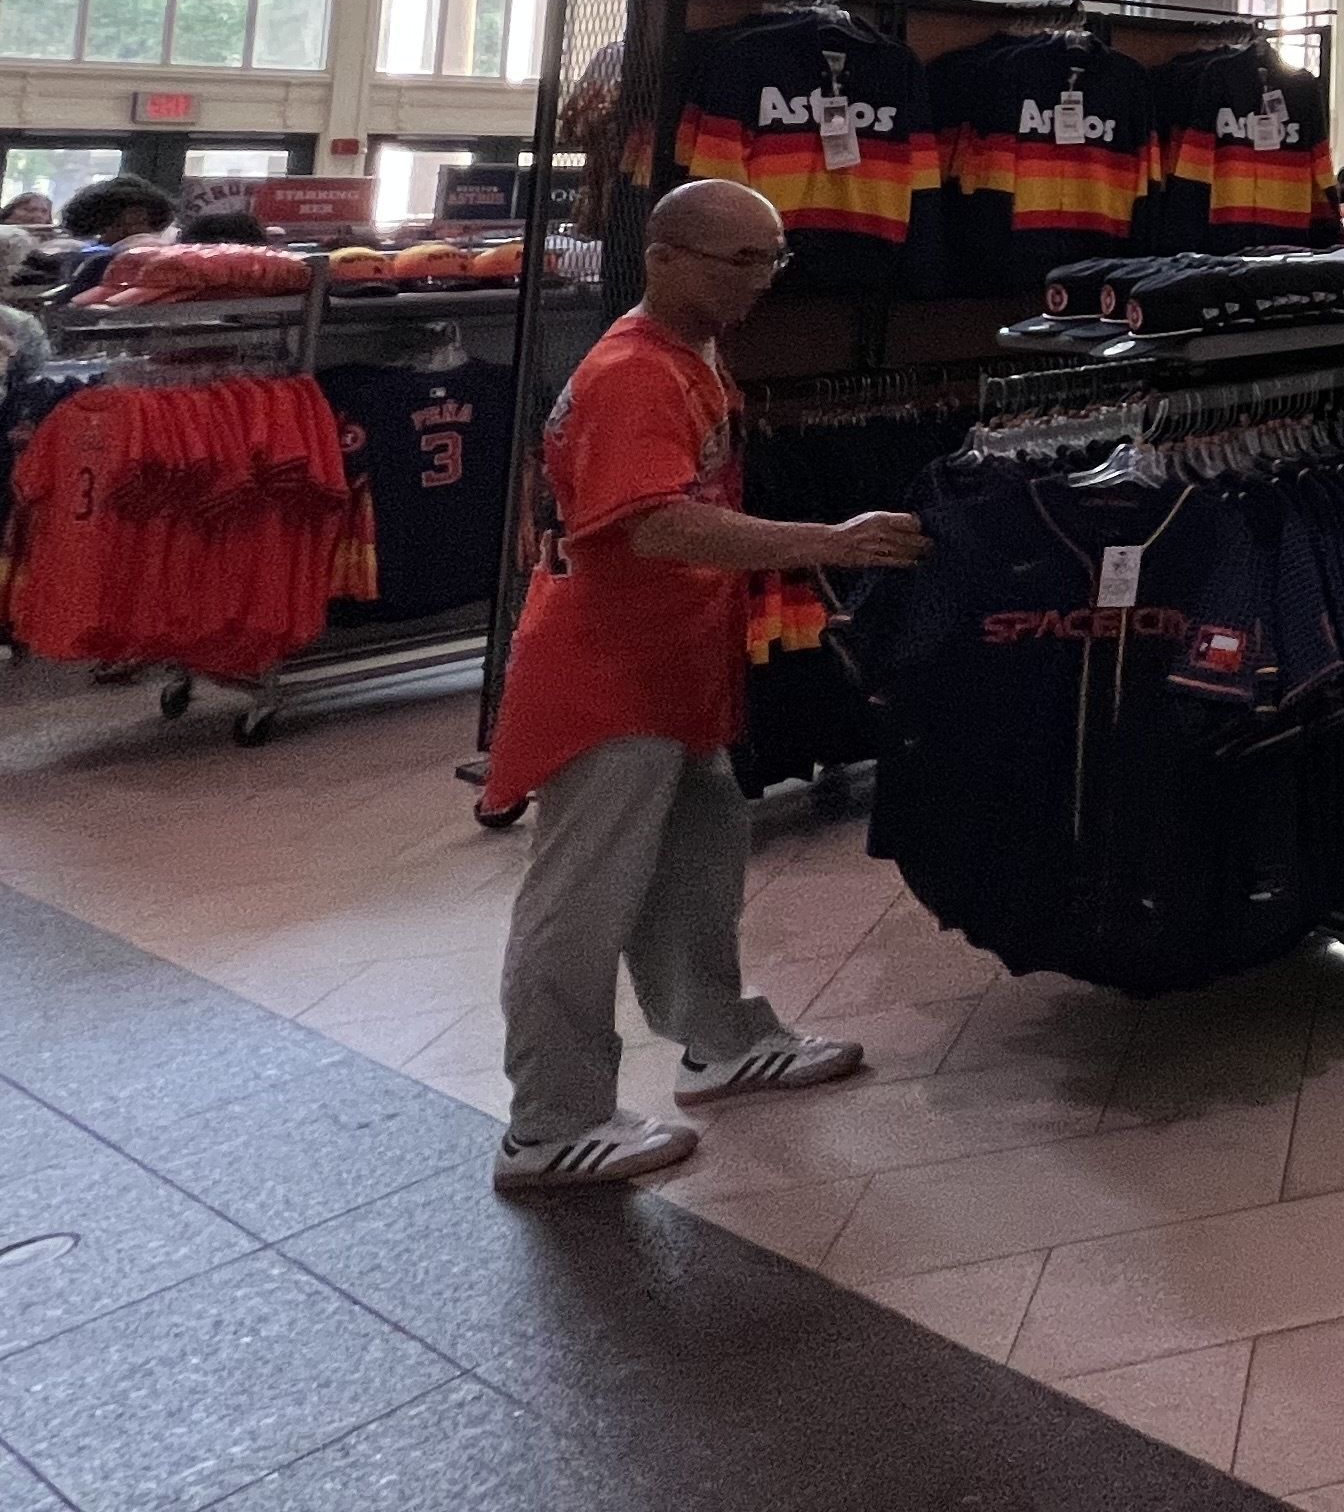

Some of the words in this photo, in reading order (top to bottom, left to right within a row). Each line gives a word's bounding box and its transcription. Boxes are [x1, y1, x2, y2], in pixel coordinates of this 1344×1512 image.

[757, 86, 898, 134] Astos
[1018, 98, 1117, 142] Asos
[420, 430, 464, 488] 3
[982, 607, 1129, 646] SPACE
